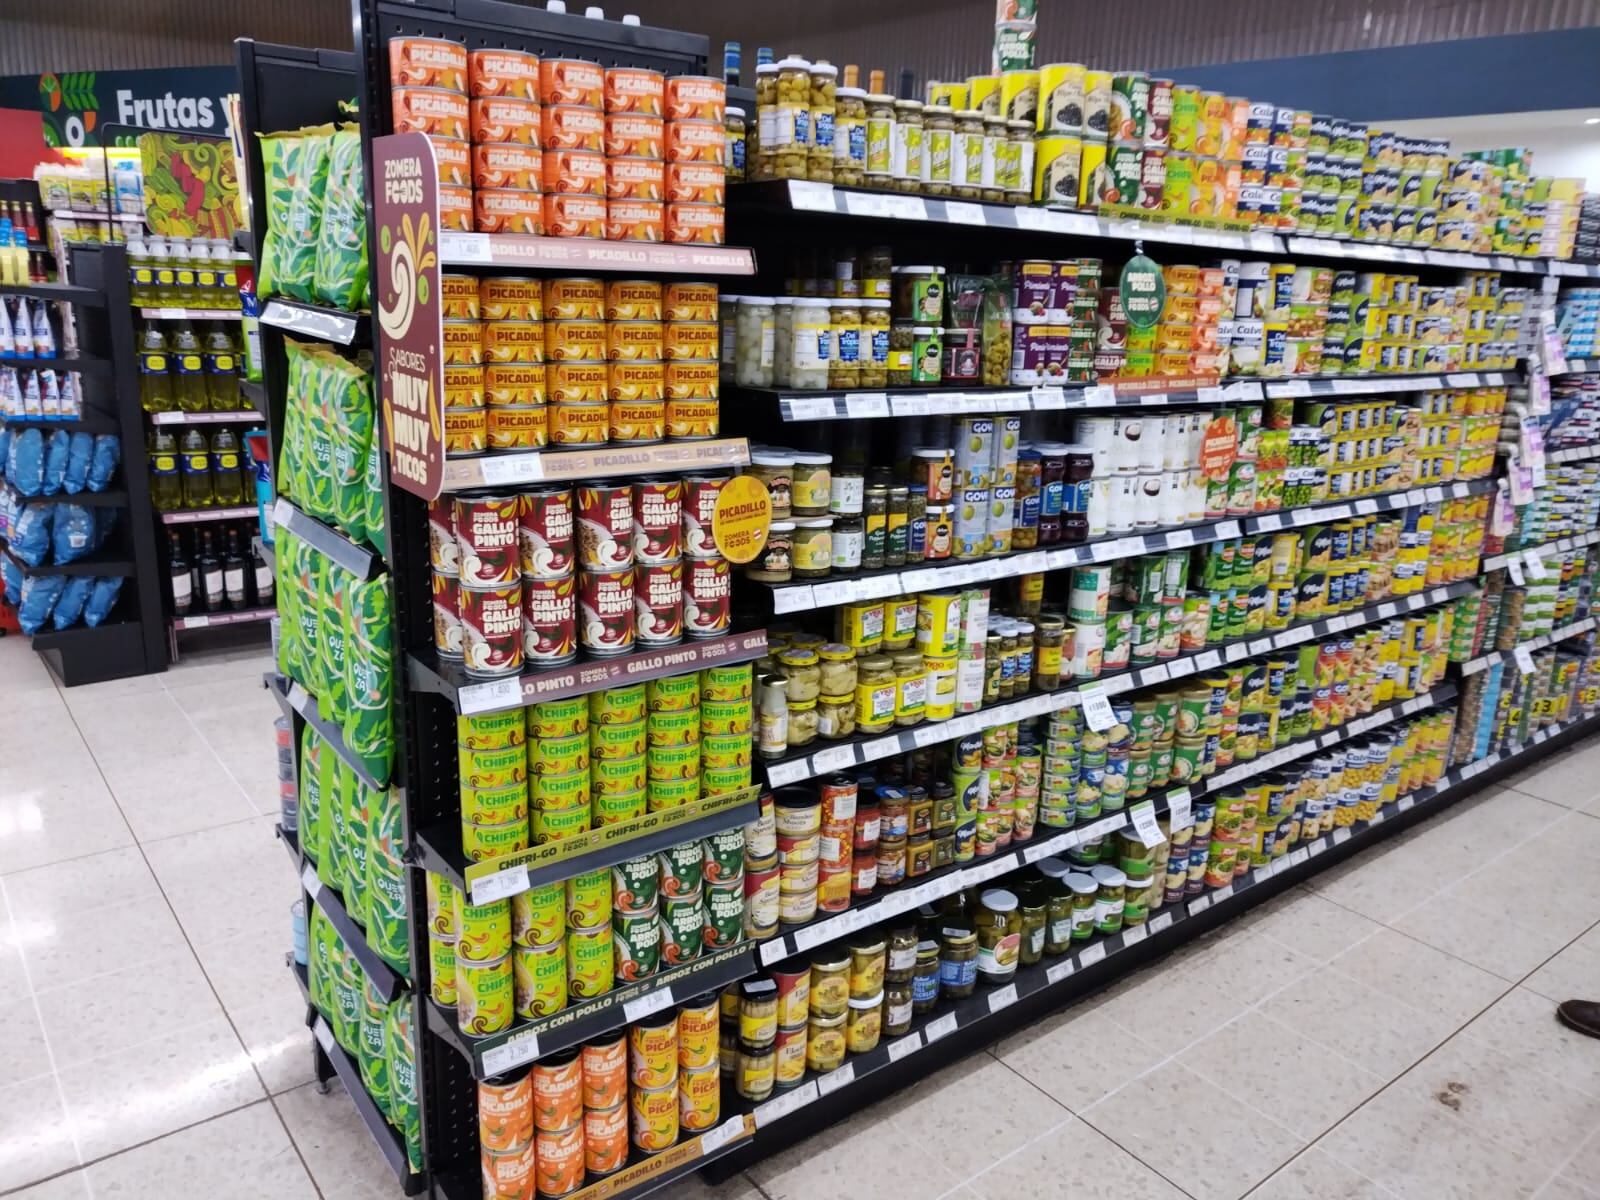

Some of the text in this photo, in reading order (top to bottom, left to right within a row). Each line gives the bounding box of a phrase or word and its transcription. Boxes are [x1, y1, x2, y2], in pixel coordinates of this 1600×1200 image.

[116, 89, 215, 128] Frutas
[385, 157, 423, 179] ZOMERA
[385, 179, 424, 204] FOODS
[588, 249, 646, 262] PICADILLO
[692, 255, 745, 267] PICADILLO
[389, 347, 426, 374] SABORES
[392, 371, 429, 415] MUY
[393, 411, 431, 455] MUY
[593, 452, 650, 467] PICADILLO
[395, 451, 428, 485] TICOS
[642, 502, 678, 515] GALLO
[719, 500, 766, 519] PICADILLO
[643, 514, 678, 526] PINTO
[473, 522, 514, 534] GALLO
[474, 534, 514, 547] PINTO
[649, 582, 682, 594] GALLO
[694, 575, 727, 587] GALLO
[597, 589, 632, 602] GALLO
[650, 592, 682, 605] PINTO
[694, 586, 727, 598] PINTO
[532, 598, 570, 611] GALLO
[599, 601, 632, 613] PINTO
[482, 607, 520, 622] GALLO
[533, 610, 570, 622] PINTO
[484, 621, 520, 634] PINTO
[627, 650, 696, 674] GALLO PINTO
[580, 667, 607, 678] ZOMERA
[581, 673, 608, 685] FOODS
[537, 675, 574, 691] PINTO
[704, 706, 749, 718] CHIFRI-GO
[701, 792, 750, 812] CHIFRI-GO
[606, 817, 658, 840] CHIFRI-GO
[498, 846, 557, 871] CHIFRI-GO
[655, 945, 746, 986] ARROZ CON POLLO
[550, 1011, 575, 1029] CON
[576, 997, 612, 1018] POLLO
[613, 1160, 663, 1189] PICADILLO
